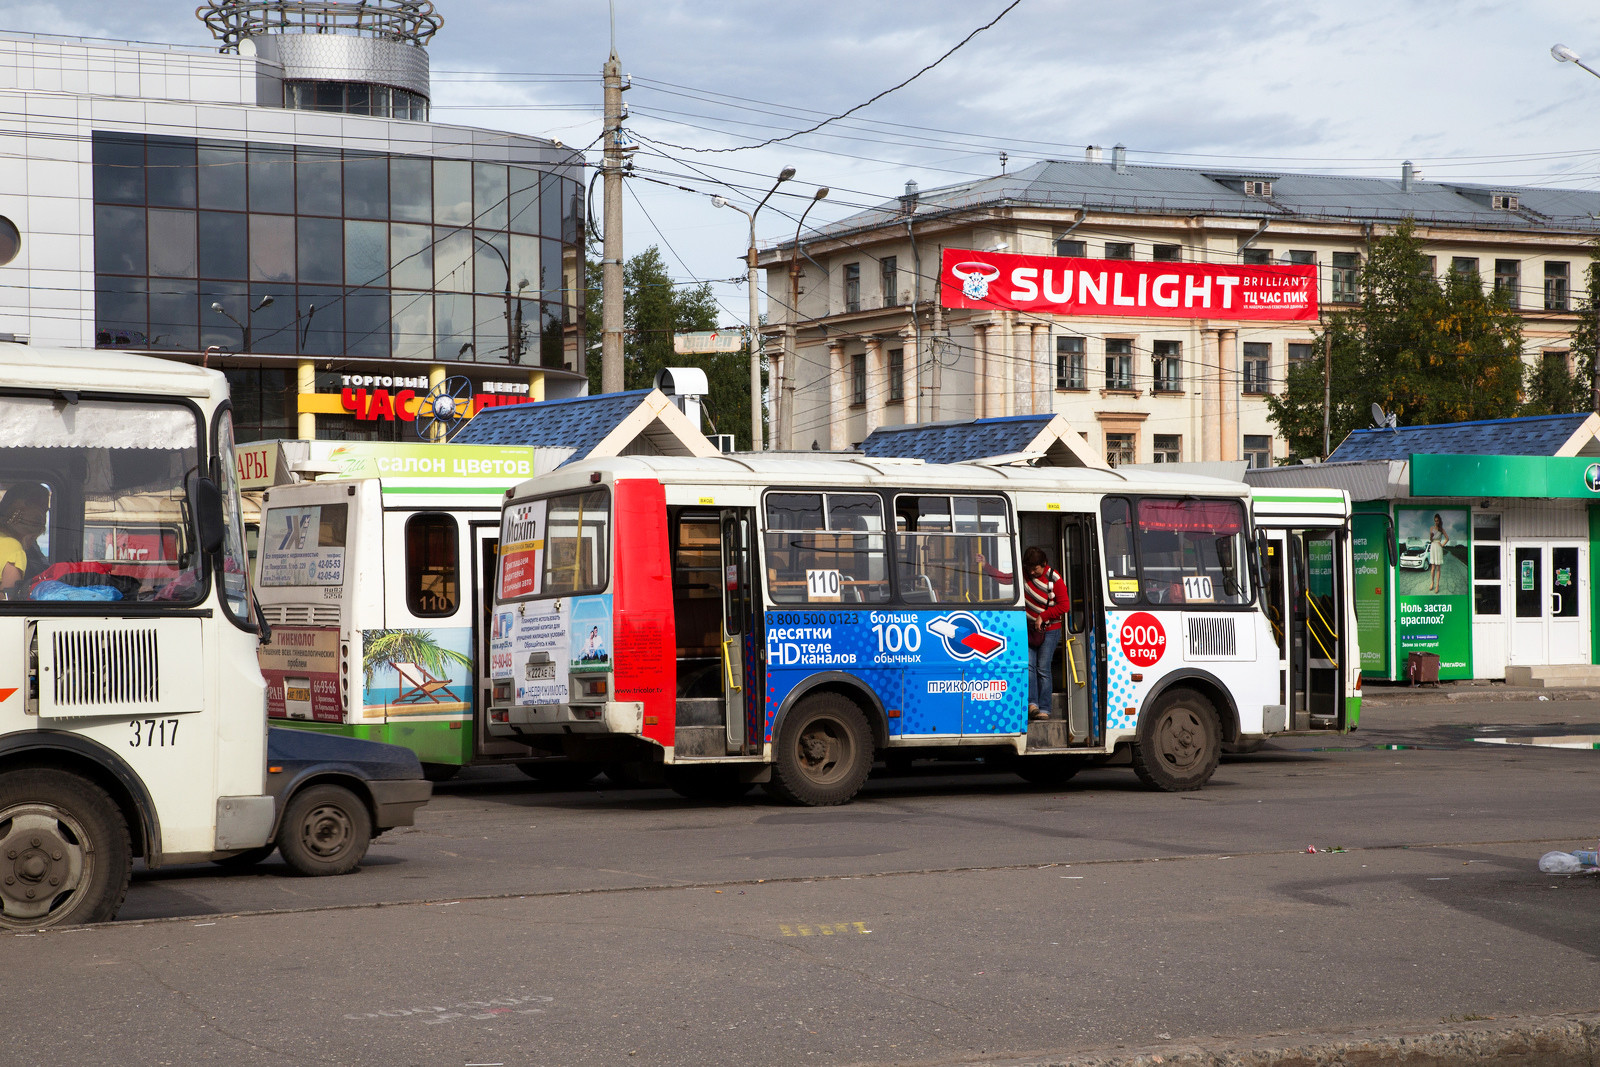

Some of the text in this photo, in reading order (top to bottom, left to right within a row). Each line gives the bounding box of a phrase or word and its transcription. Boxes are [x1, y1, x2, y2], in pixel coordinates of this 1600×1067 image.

[1010, 267, 1240, 309] SUNLIGHT
[1243, 276, 1308, 287] BRILLIANT
[1243, 291, 1308, 305] ТЦ ЧАС ПИК
[341, 375, 429, 389] ТОРГОВЫЙ
[482, 381, 530, 394] ЦЕНТР
[341, 388, 416, 422] ЧАС
[378, 456, 531, 477] салон цветов
[506, 515, 536, 543] Maxim
[318, 560, 341, 569] 42-05-53
[317, 571, 341, 580] 42-05-49
[808, 571, 839, 594] 110
[1185, 577, 1212, 599] 110
[419, 595, 447, 610] 110
[1400, 602, 1452, 613] Ноль застал
[767, 613, 859, 625] 8 800 500 0123
[870, 611, 919, 624] больше
[1400, 614, 1444, 627] врасплох?
[492, 612, 514, 640] АГР
[277, 632, 316, 646] ГИНЕКОЛОГ
[767, 627, 832, 643] десятки
[871, 623, 922, 653] 100
[767, 643, 801, 665] HD
[801, 643, 832, 654] теле
[1130, 649, 1157, 660] в год
[801, 653, 857, 665] каналов
[874, 653, 922, 664] обычных
[313, 680, 337, 694] 66-93-66
[615, 686, 663, 694] www.tricolor.tv
[971, 692, 1002, 700] FULL HD
[129, 719, 179, 747] 3717
